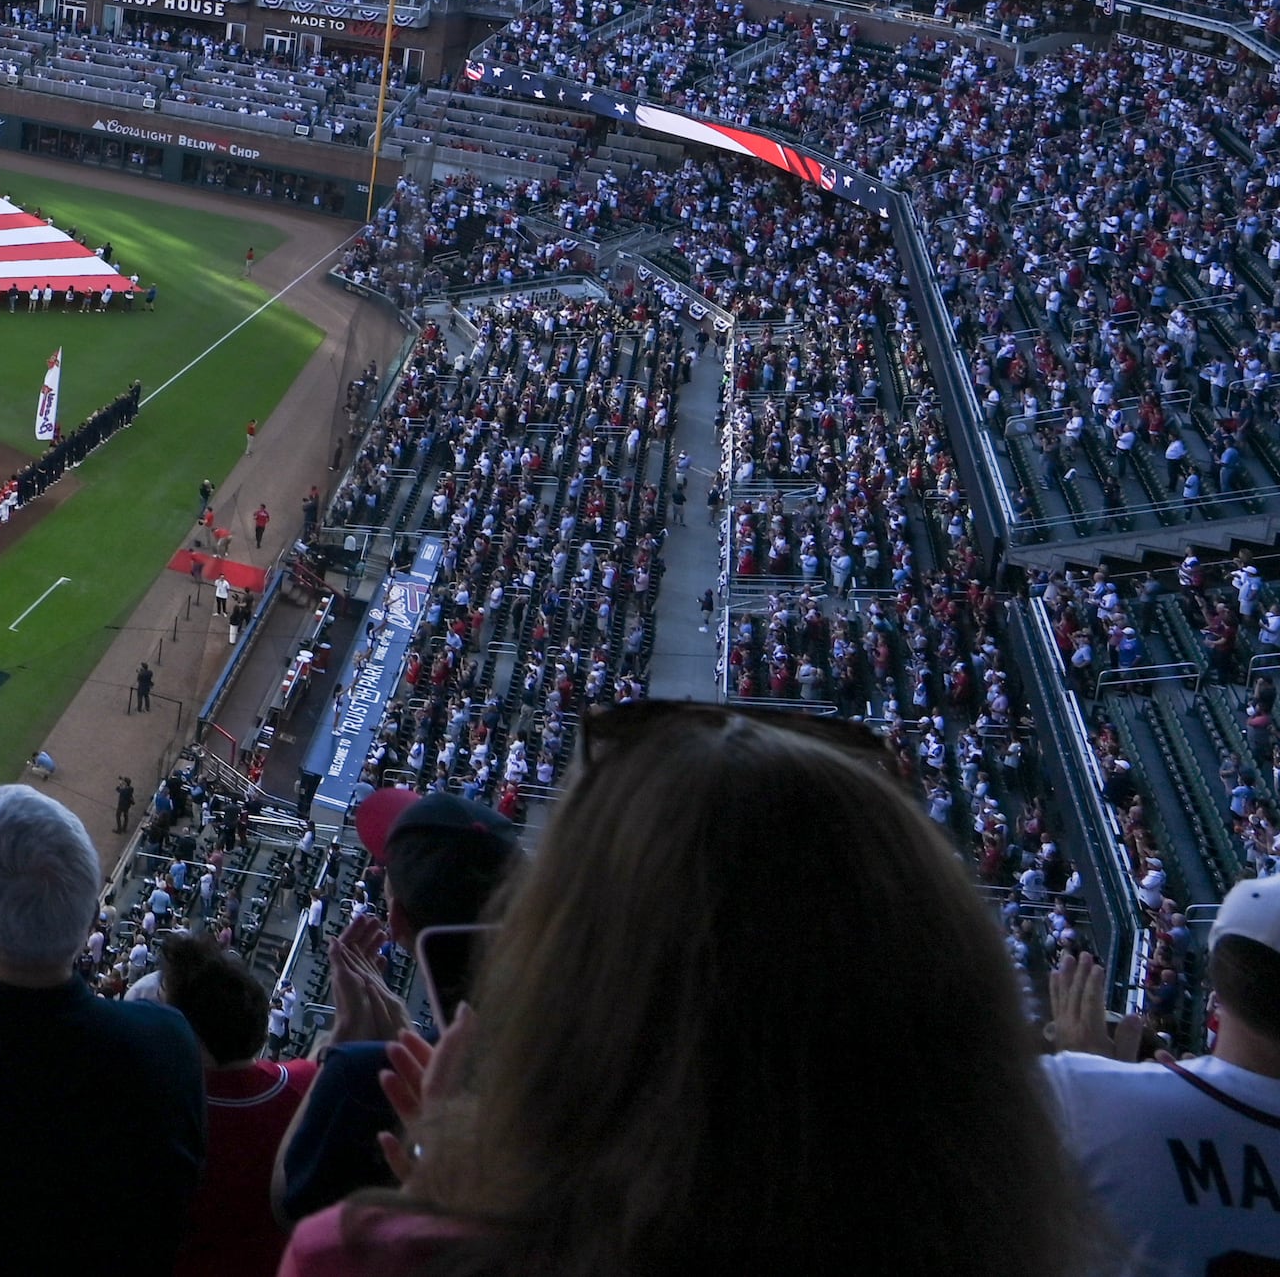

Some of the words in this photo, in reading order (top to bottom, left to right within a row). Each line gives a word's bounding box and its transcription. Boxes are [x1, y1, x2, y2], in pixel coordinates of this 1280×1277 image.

[290, 14, 326, 29] MADE
[329, 19, 346, 31] TO
[106, 120, 140, 137] Coors
[141, 130, 173, 144] LIGHT
[178, 134, 217, 152] BELOW
[229, 144, 261, 160] CHOP
[340, 699, 370, 737] TRUIST
[362, 664, 385, 690] PARK
[327, 748, 350, 778] WELCOME
[341, 737, 352, 749] TO
